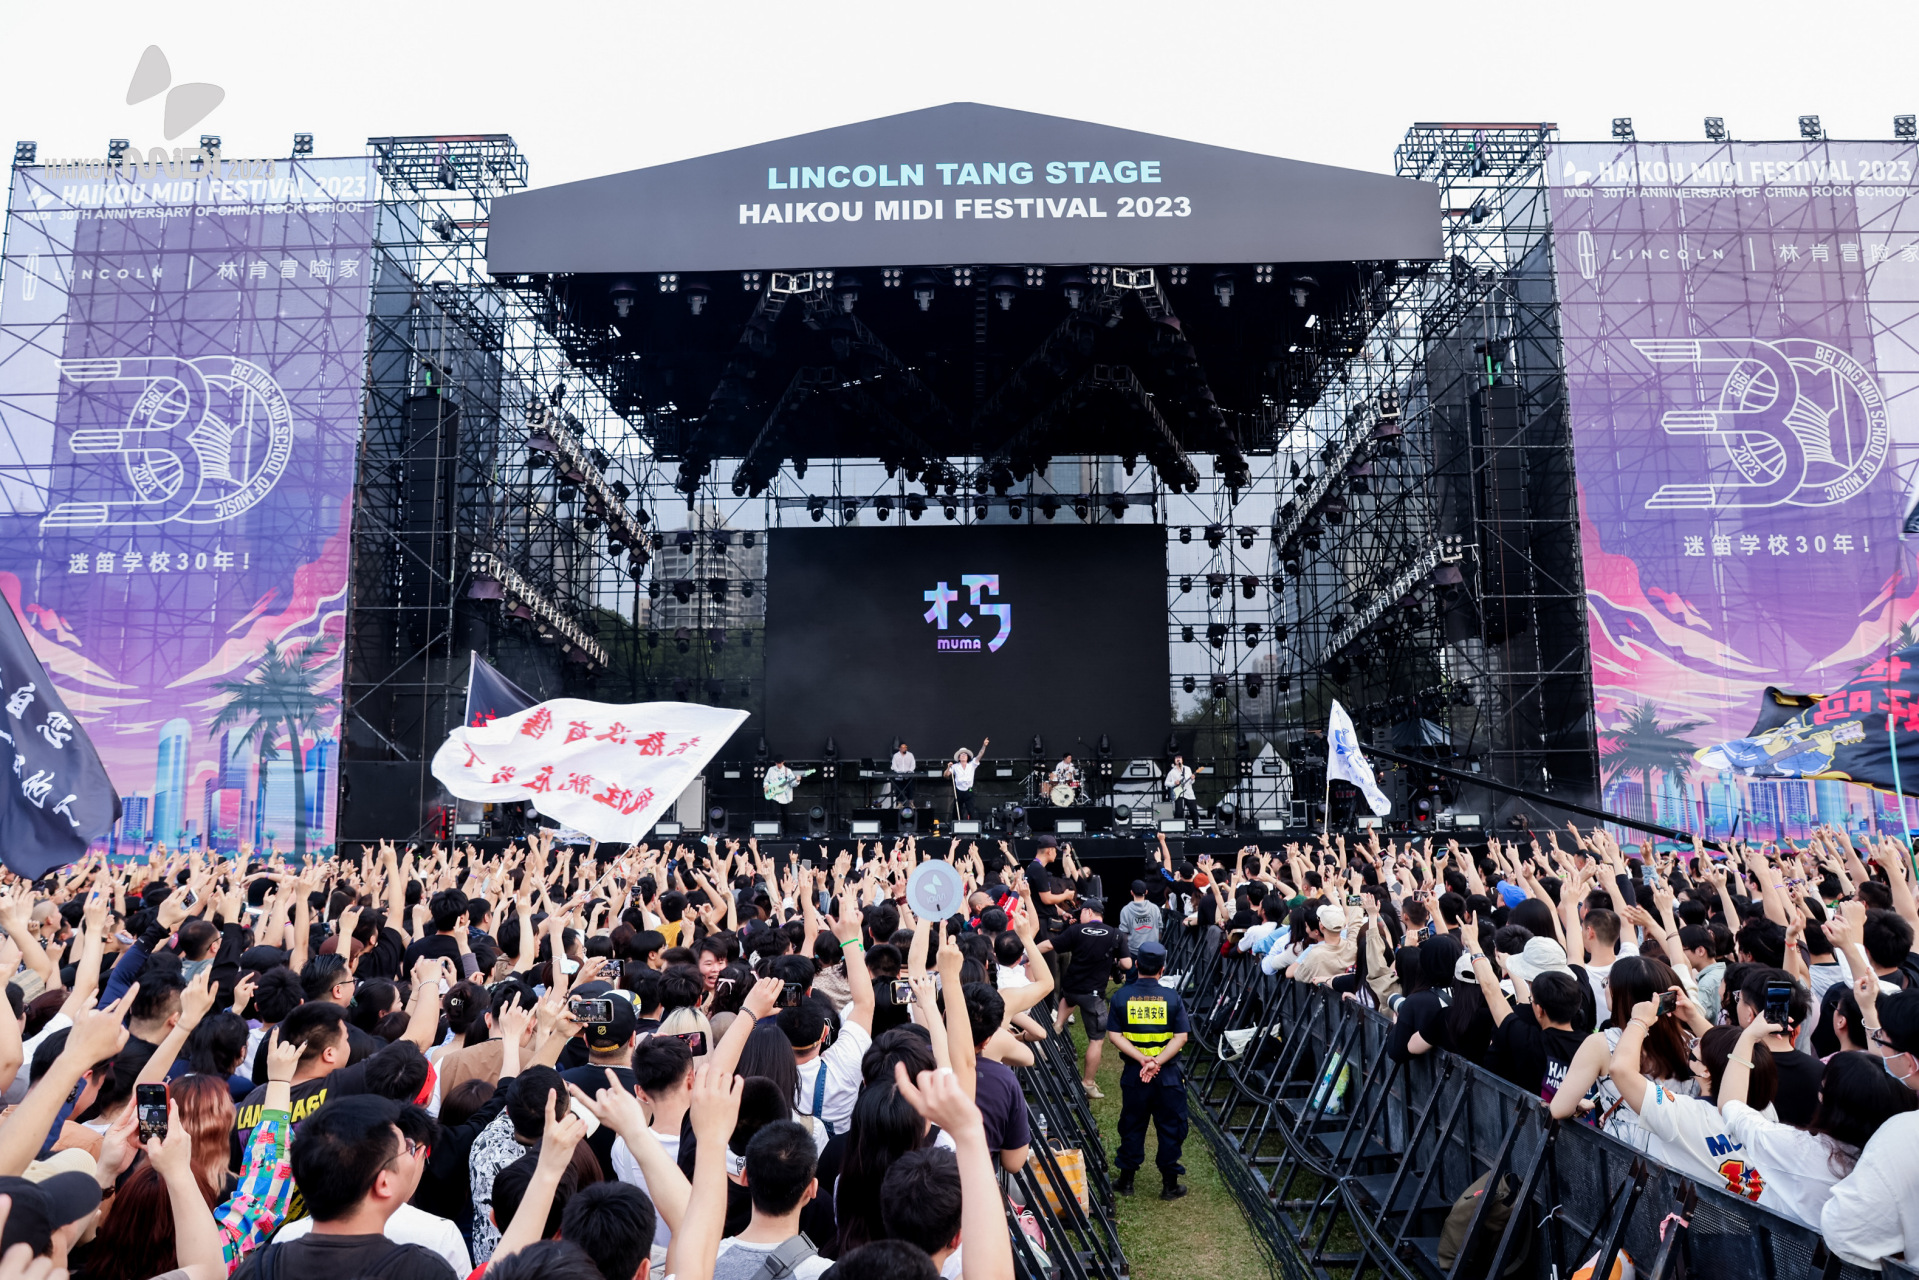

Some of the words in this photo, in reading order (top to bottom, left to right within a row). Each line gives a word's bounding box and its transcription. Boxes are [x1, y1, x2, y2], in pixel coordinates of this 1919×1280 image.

[767, 164, 925, 189] LINCOLN
[935, 162, 1035, 186] TANG
[1045, 160, 1162, 184] STAGE
[1599, 161, 1684, 183] HAIKOU
[1690, 161, 1744, 183] MIDI
[1750, 160, 1854, 182] FESTIVAL
[1858, 160, 1912, 182] 2023
[61, 183, 147, 206] HAIKOU
[151, 181, 201, 203] MIDI
[208, 178, 309, 201] FESTIVAL
[313, 176, 368, 198] 2023
[1602, 187, 1636, 198] 30TH
[1639, 187, 1738, 199] ANNIVERSARY
[1742, 187, 1760, 198] OF
[1764, 187, 1808, 198] CHINA
[1812, 186, 1853, 197] ROCK
[1856, 186, 1914, 197] SCHOOL
[59, 210, 92, 221] 30TH
[94, 207, 193, 220] ANNIVERSARY
[195, 206, 214, 217] OF
[217, 205, 260, 216] CHINA
[263, 203, 304, 215] ROCK
[306, 202, 366, 214] SCHOOL
[739, 201, 864, 224] HAIKOU
[874, 199, 944, 222] MIDI
[955, 197, 1108, 220] FESTIVAL
[1116, 195, 1193, 218] 2023
[1613, 249, 1724, 260] LINCOLN
[1779, 243, 1919, 263] 林肯冒险家
[54, 267, 163, 281] LINCOLN
[217, 258, 360, 280] 林肯冒险家
[1727, 369, 1751, 398] 1993
[1857, 382, 1879, 409] MIDI
[138, 387, 164, 415] 1993
[267, 396, 288, 424] MIDI
[1866, 410, 1886, 460] SCHOOL
[263, 426, 289, 476] SCHOOL
[1732, 445, 1762, 477] 2023
[132, 463, 157, 495] 2023
[1859, 460, 1876, 479] OF
[253, 476, 271, 496] OF
[1824, 473, 1864, 501] MUSIC
[214, 490, 256, 518] MUSIC
[1134, 917, 1152, 925] VANS
